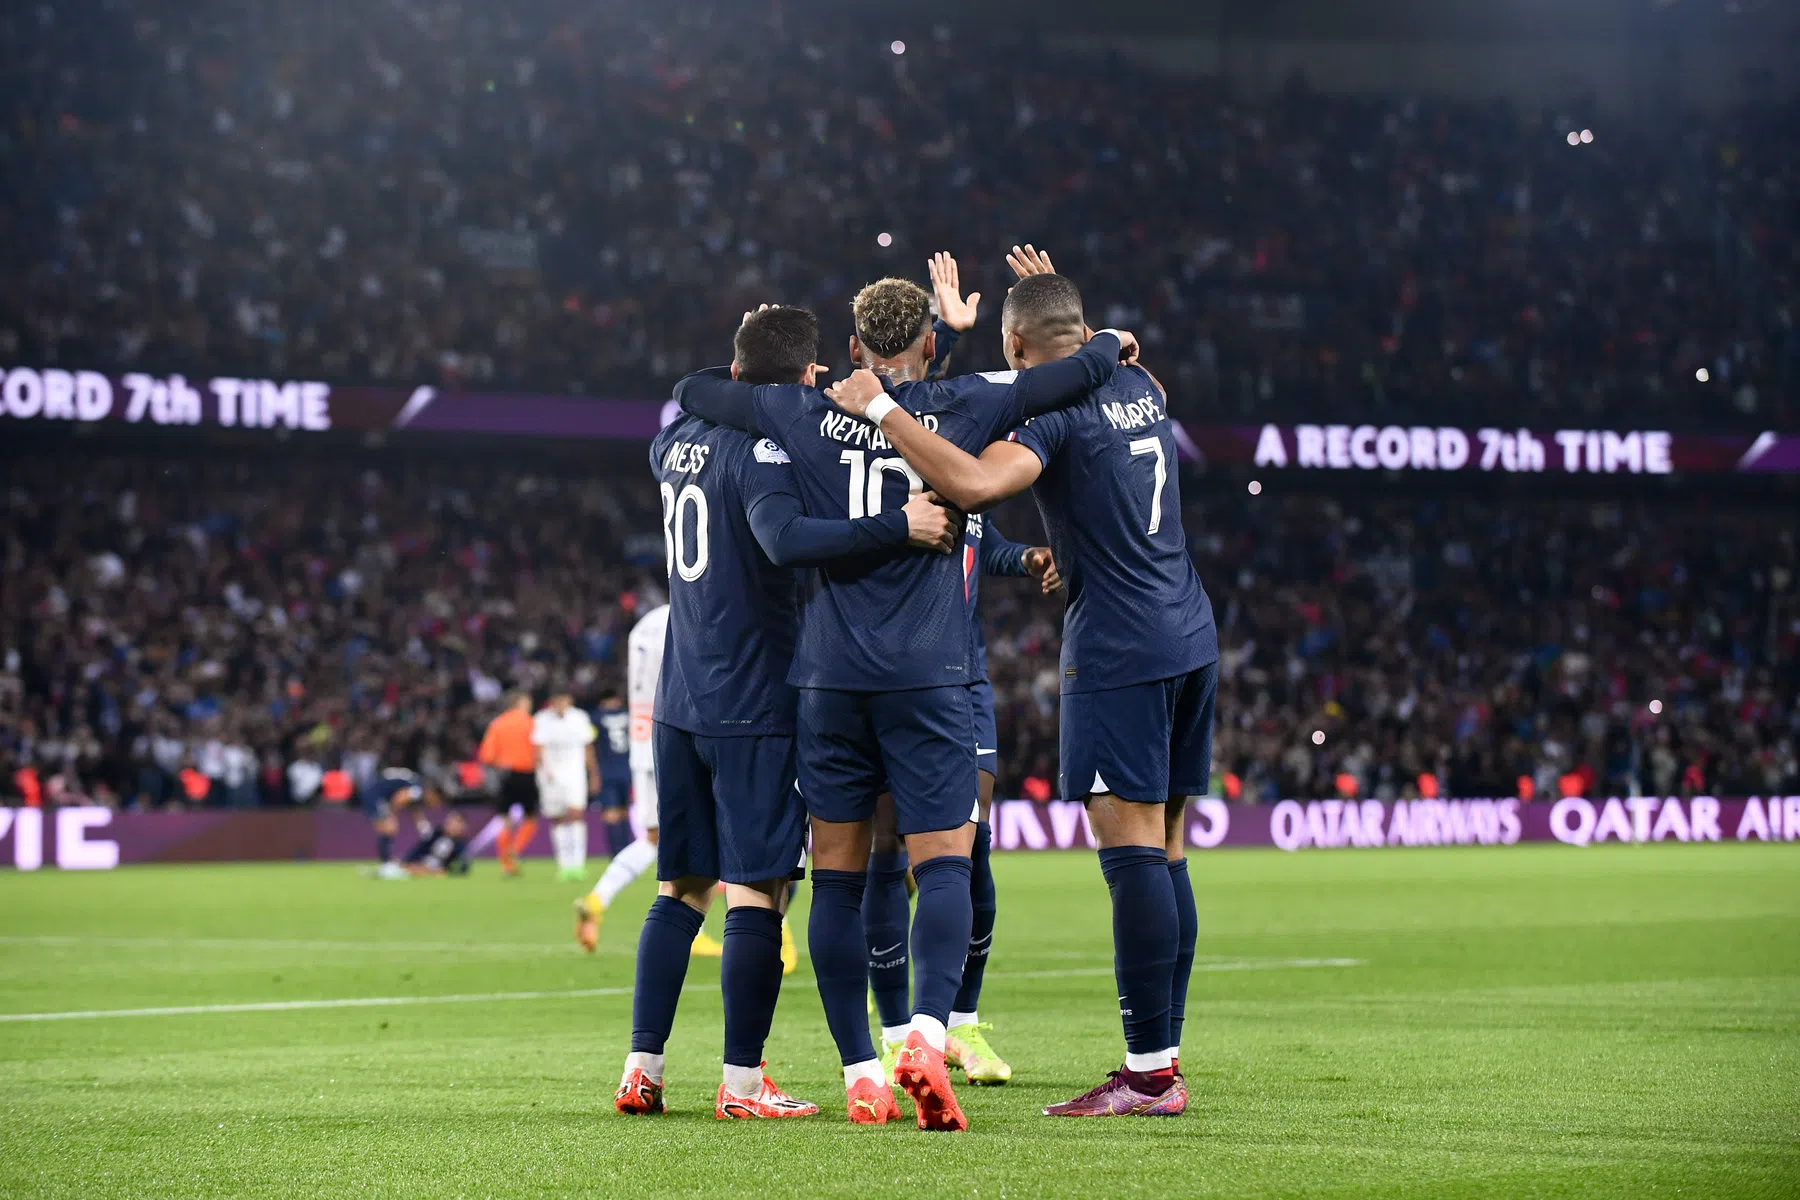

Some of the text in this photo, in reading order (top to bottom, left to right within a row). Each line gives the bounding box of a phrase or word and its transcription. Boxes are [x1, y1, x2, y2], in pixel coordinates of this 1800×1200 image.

[122, 372, 201, 425] 7th
[209, 377, 332, 431] TIME
[820, 410, 893, 450] NEYMA
[1253, 422, 1674, 474] A RECORD 7th TIME
[839, 449, 924, 520] 10
[1129, 436, 1167, 535] 7
[1270, 798, 1386, 852] QATAR
[1387, 797, 1522, 845] AIRWAYS
[1550, 796, 1722, 847] QATAR
[868, 956, 906, 969] PARIS
